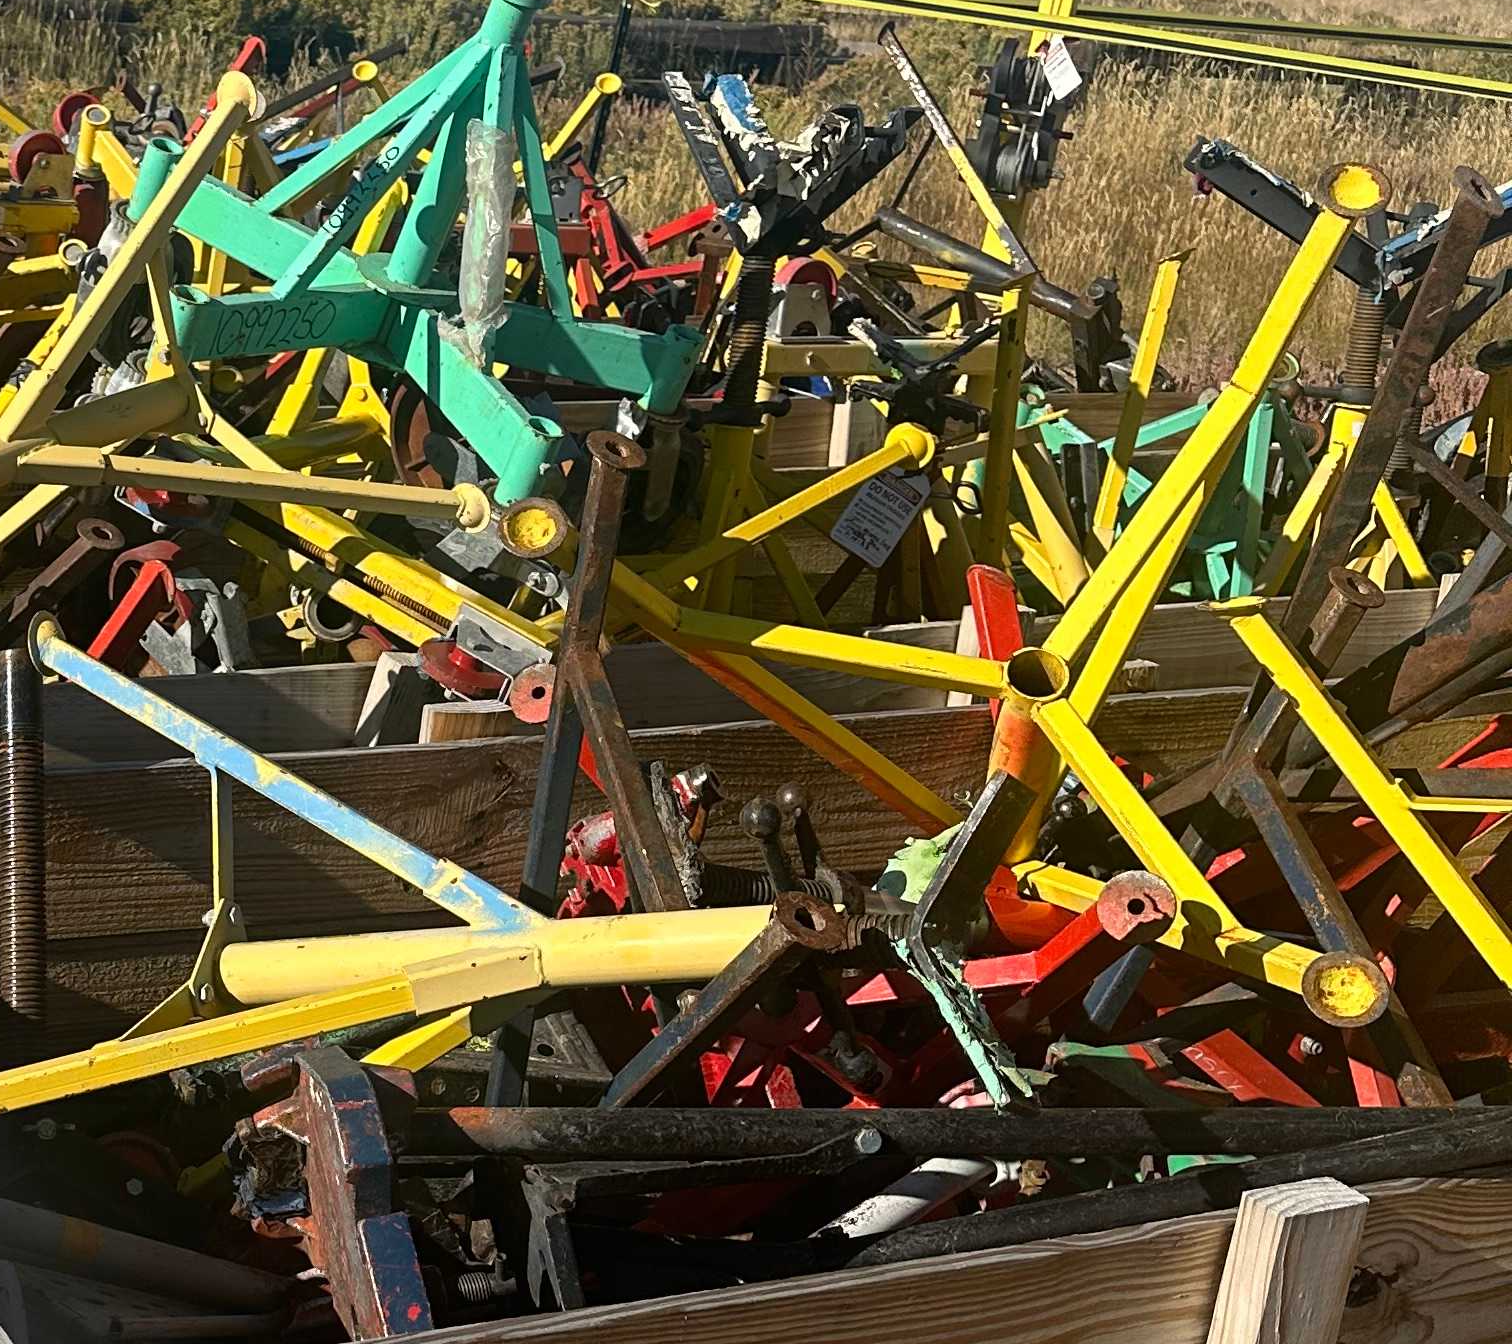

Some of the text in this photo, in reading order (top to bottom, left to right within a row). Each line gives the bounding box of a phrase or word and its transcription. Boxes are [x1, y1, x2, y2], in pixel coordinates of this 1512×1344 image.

[208, 300, 336, 356] 10992250
[868, 481, 882, 494] DO
[882, 489, 900, 505] NOT
